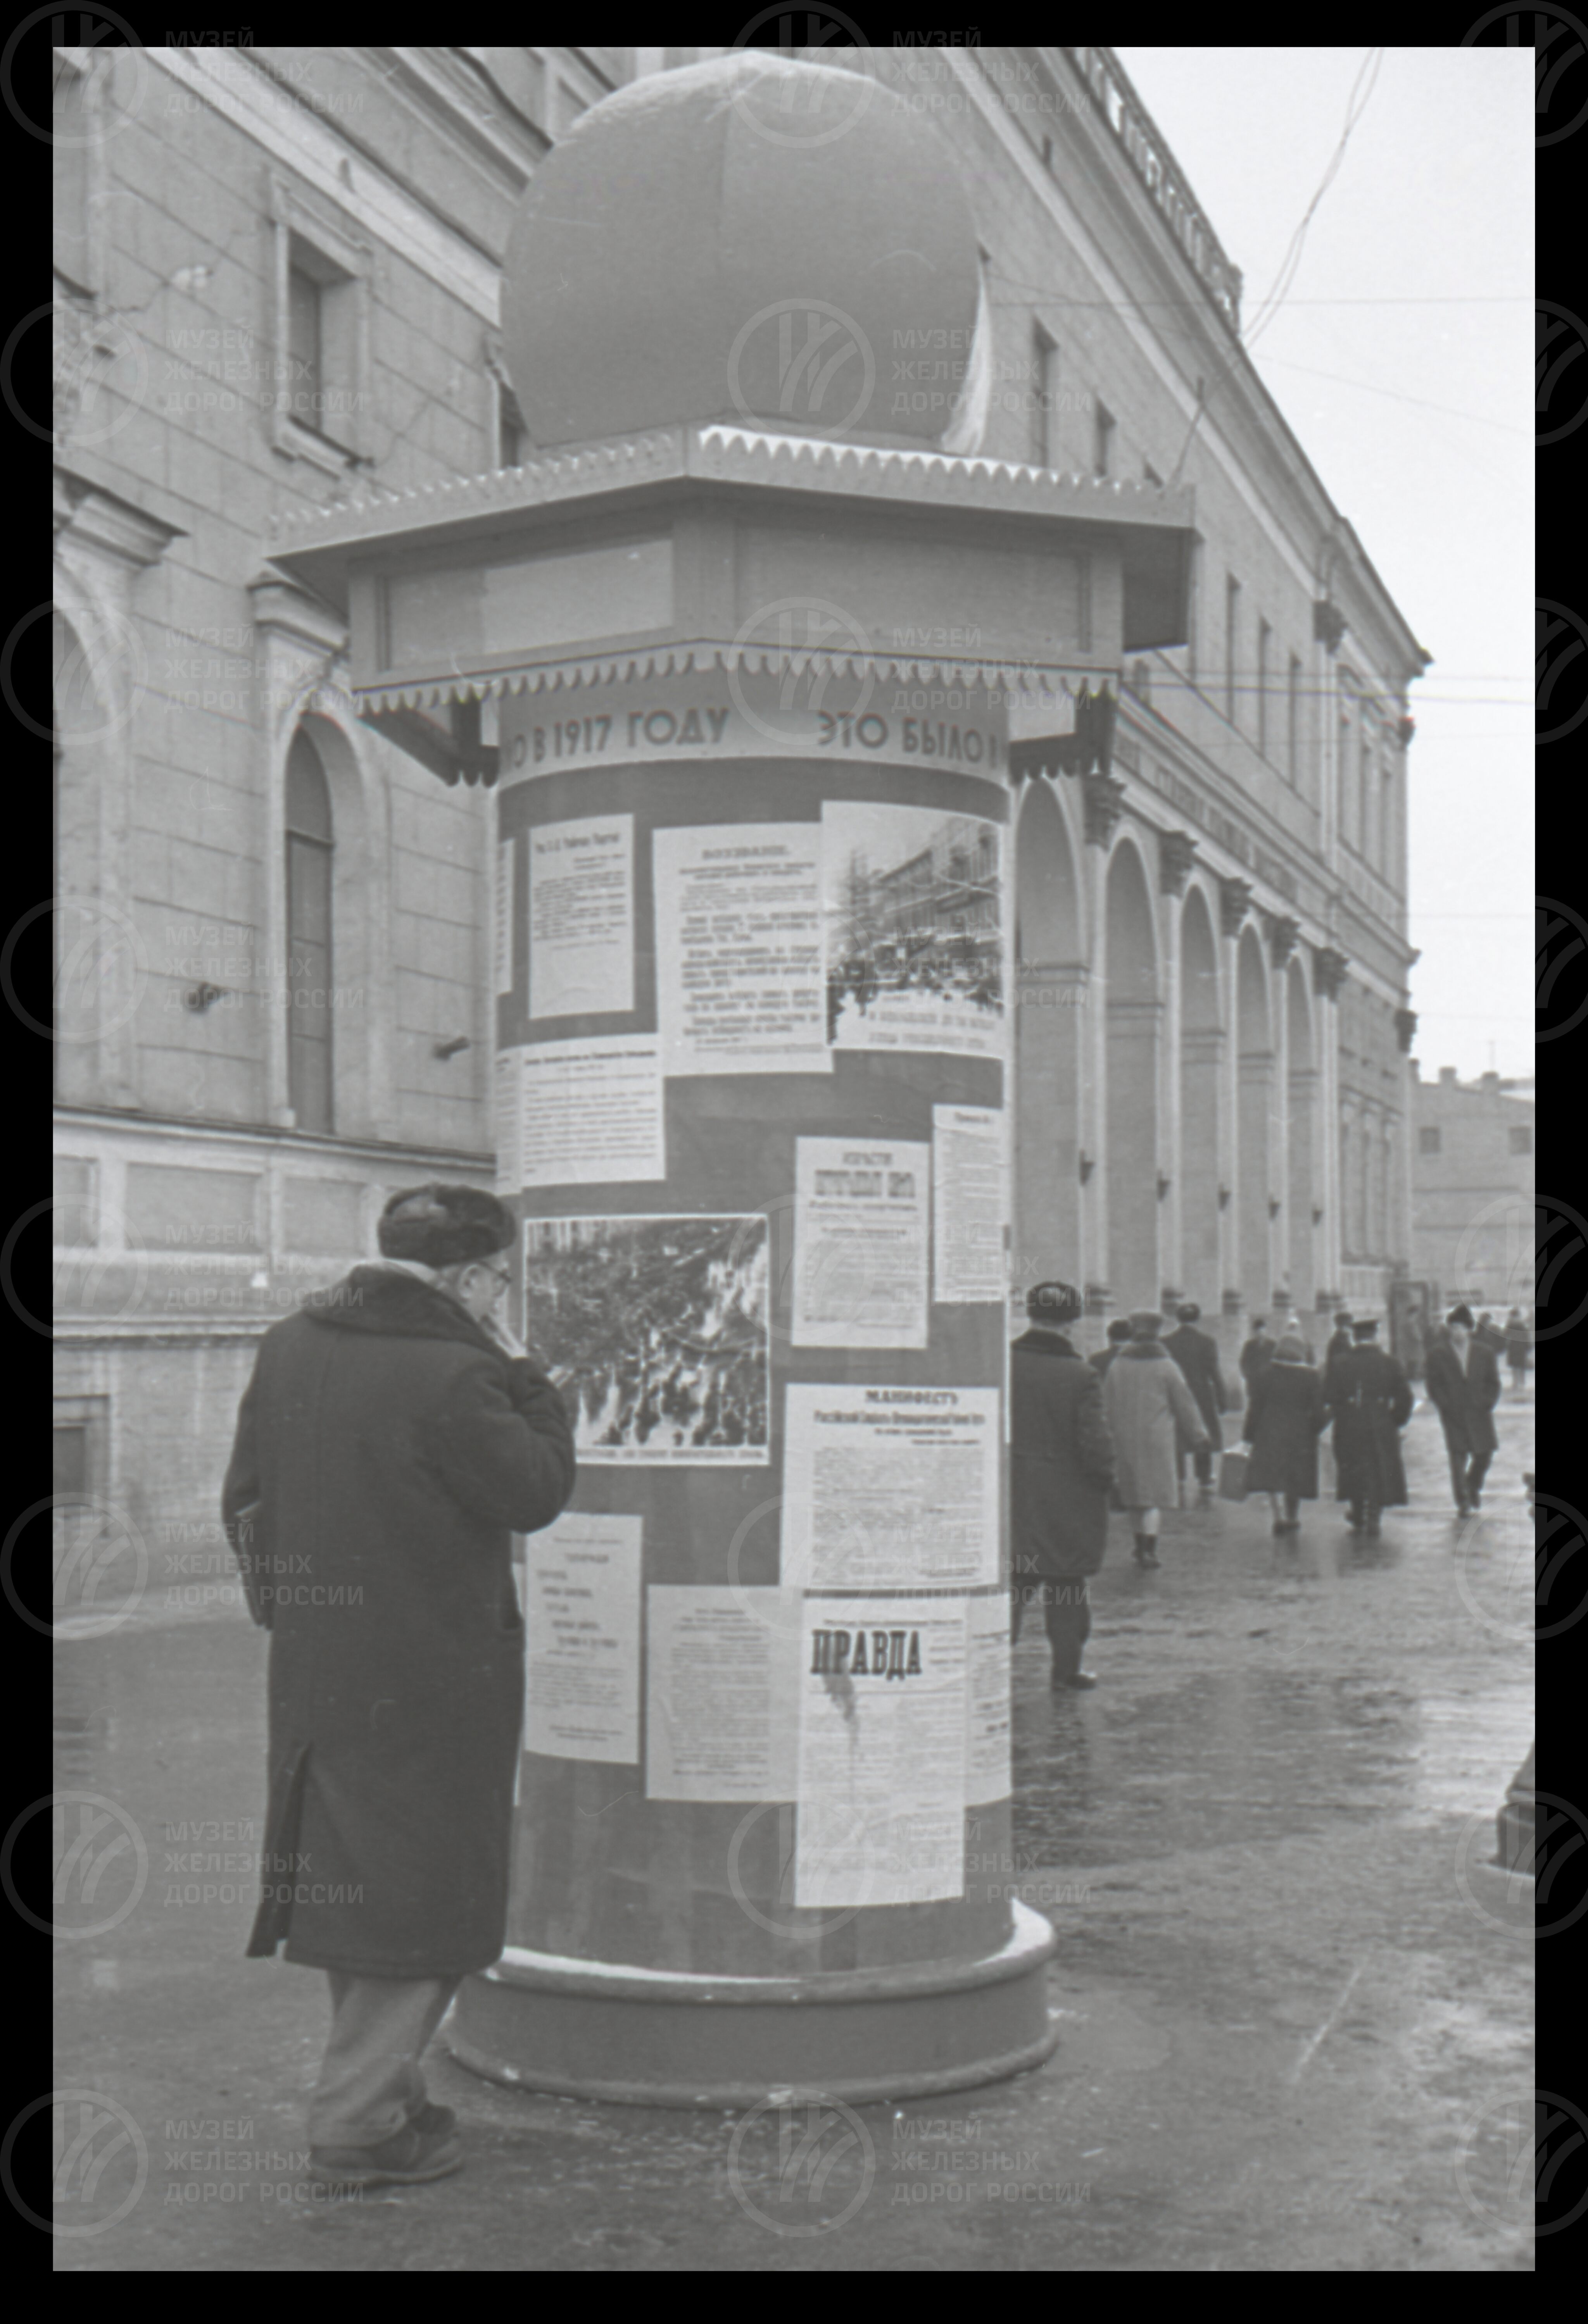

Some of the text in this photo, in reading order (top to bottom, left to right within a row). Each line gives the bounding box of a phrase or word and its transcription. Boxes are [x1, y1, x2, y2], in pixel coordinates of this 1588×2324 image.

[554, 714, 612, 757] 1917
[627, 707, 730, 747] ГОДУ
[817, 709, 889, 749] ЭТО
[902, 717, 983, 763] БЫЛО
[810, 1629, 922, 1681] ПРАВДА
